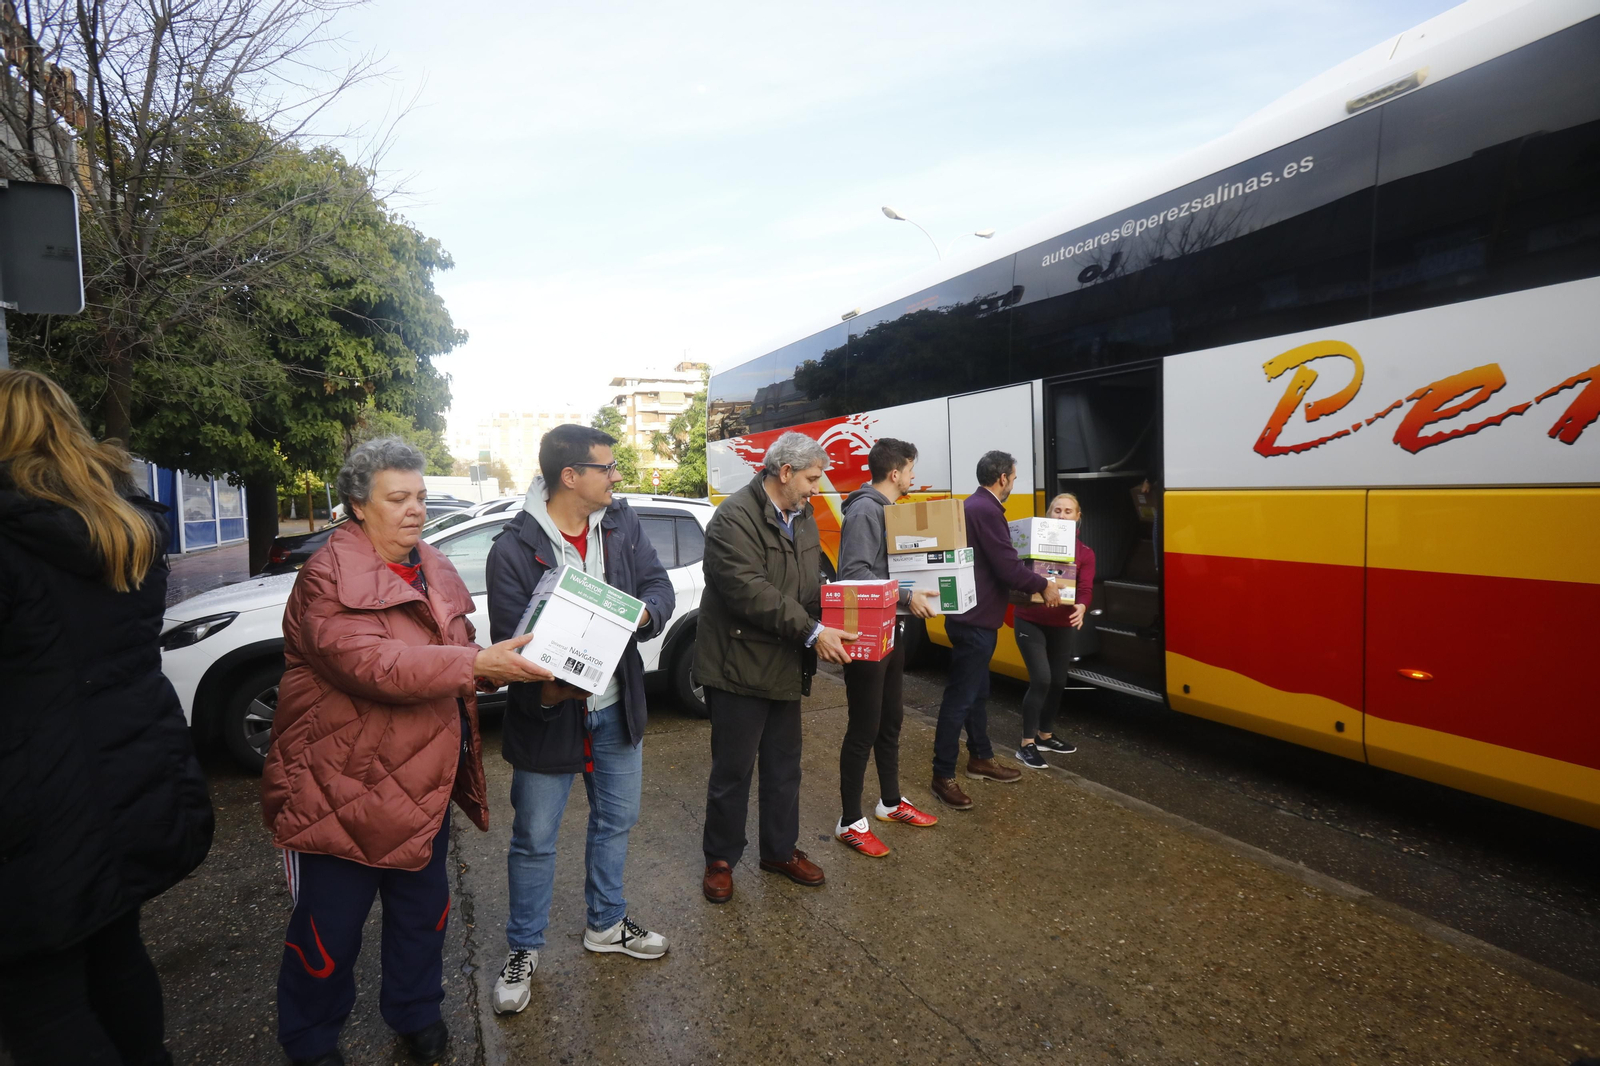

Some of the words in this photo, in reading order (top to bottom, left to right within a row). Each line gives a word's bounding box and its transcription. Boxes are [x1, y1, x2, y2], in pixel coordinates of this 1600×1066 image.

[1041, 154, 1315, 267] autocares@perezsalinas.es
[569, 573, 603, 594] NAVIGATOR
[603, 599, 612, 609] 80
[540, 653, 552, 664] 80
[569, 646, 603, 667] NAVIGATOR
